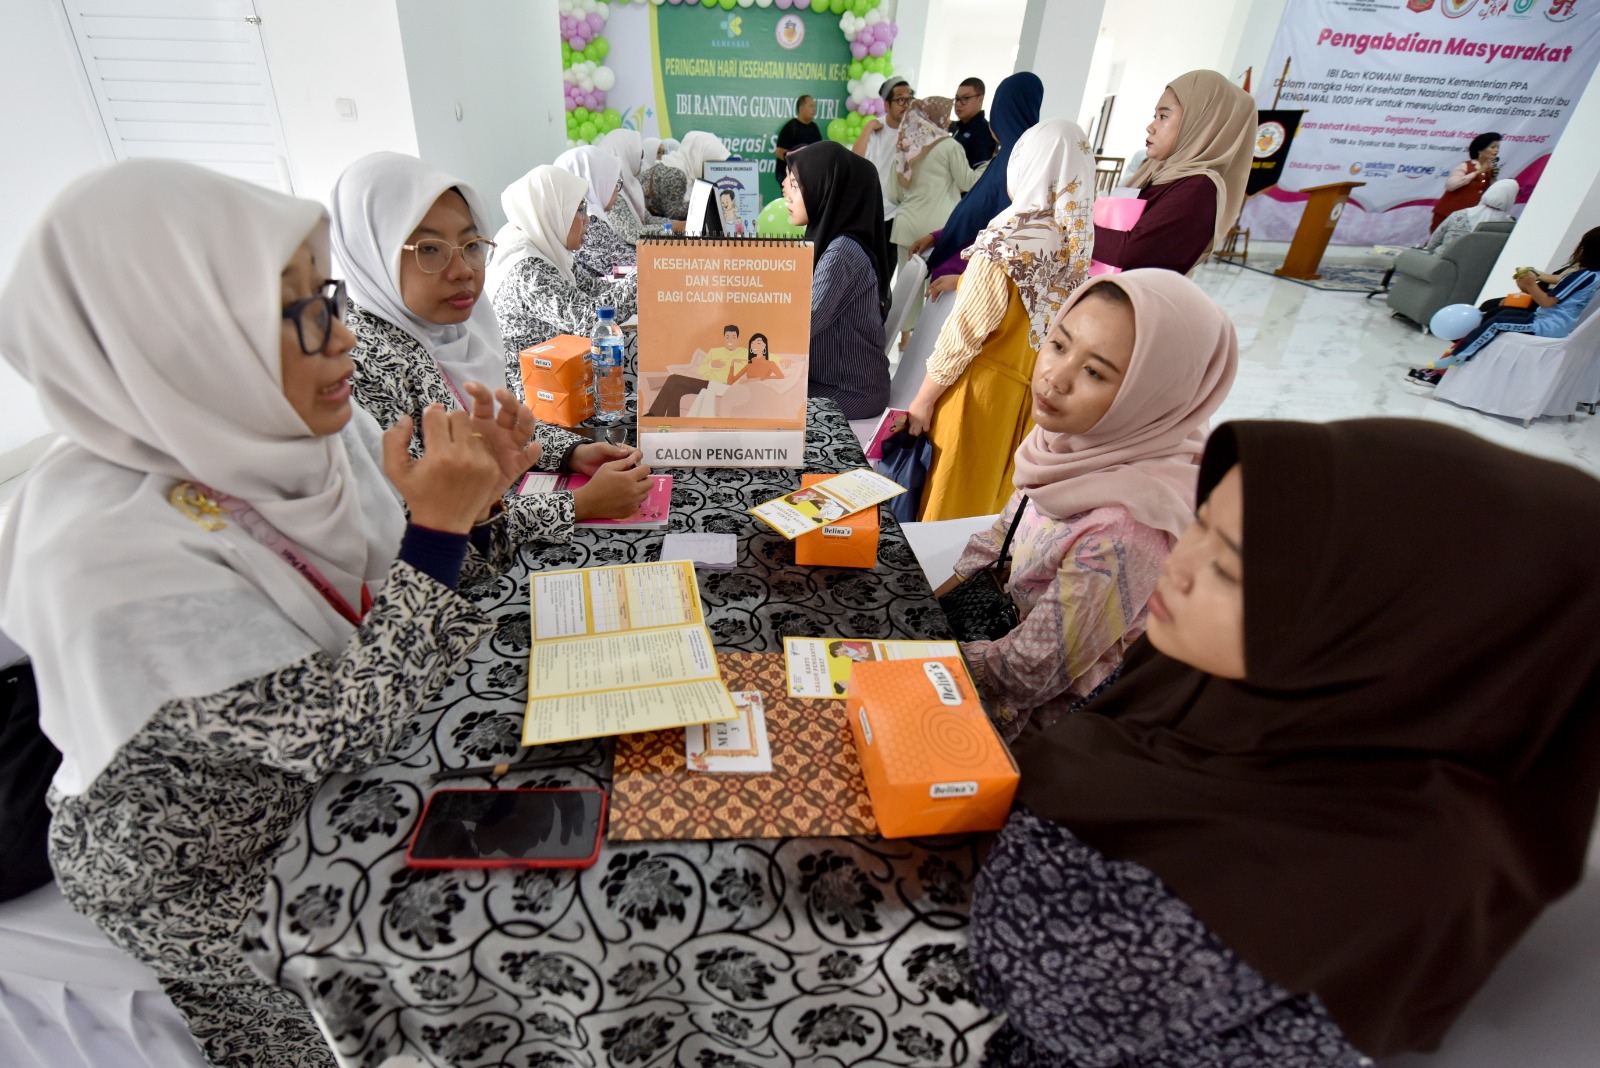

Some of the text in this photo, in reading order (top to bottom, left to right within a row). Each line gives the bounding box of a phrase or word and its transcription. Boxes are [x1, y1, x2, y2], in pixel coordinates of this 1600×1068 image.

[711, 40, 750, 48] KEMENKES
[1317, 28, 1573, 63] Pengabdian Masyarakat
[665, 58, 715, 76] PERINGATAN
[717, 60, 737, 77] HARI
[739, 60, 784, 79] KESEHATAN
[786, 62, 827, 80] NASIONAL
[1326, 69, 1528, 91] IBI Dan KOWANI Bersama Kementerian PPA
[1273, 79, 1570, 106] Dalam rangka Hari Kesehatan Nasional dan Peringatan Hari Ibu
[676, 94, 692, 115] IBI
[693, 95, 748, 117] RANTING
[1278, 92, 1560, 118] MENGAWAL 1000 HPK untuk mewujudkan Generasi Emas 2045
[1318, 122, 1343, 130] sehat
[1344, 123, 1384, 135] keluarga
[1430, 129, 1457, 138] untuk
[1397, 164, 1435, 175] DANONE
[653, 258, 796, 271] KESEHATAN REPRODUKSI
[685, 275, 764, 287] DAN SEKSUAL
[657, 291, 792, 304] BAGI CALON PENGANTIN
[655, 448, 787, 460] CALON PENGANTIN
[824, 526, 851, 535] Delina's
[928, 663, 957, 700] Delina's
[717, 721, 728, 747] MEJ
